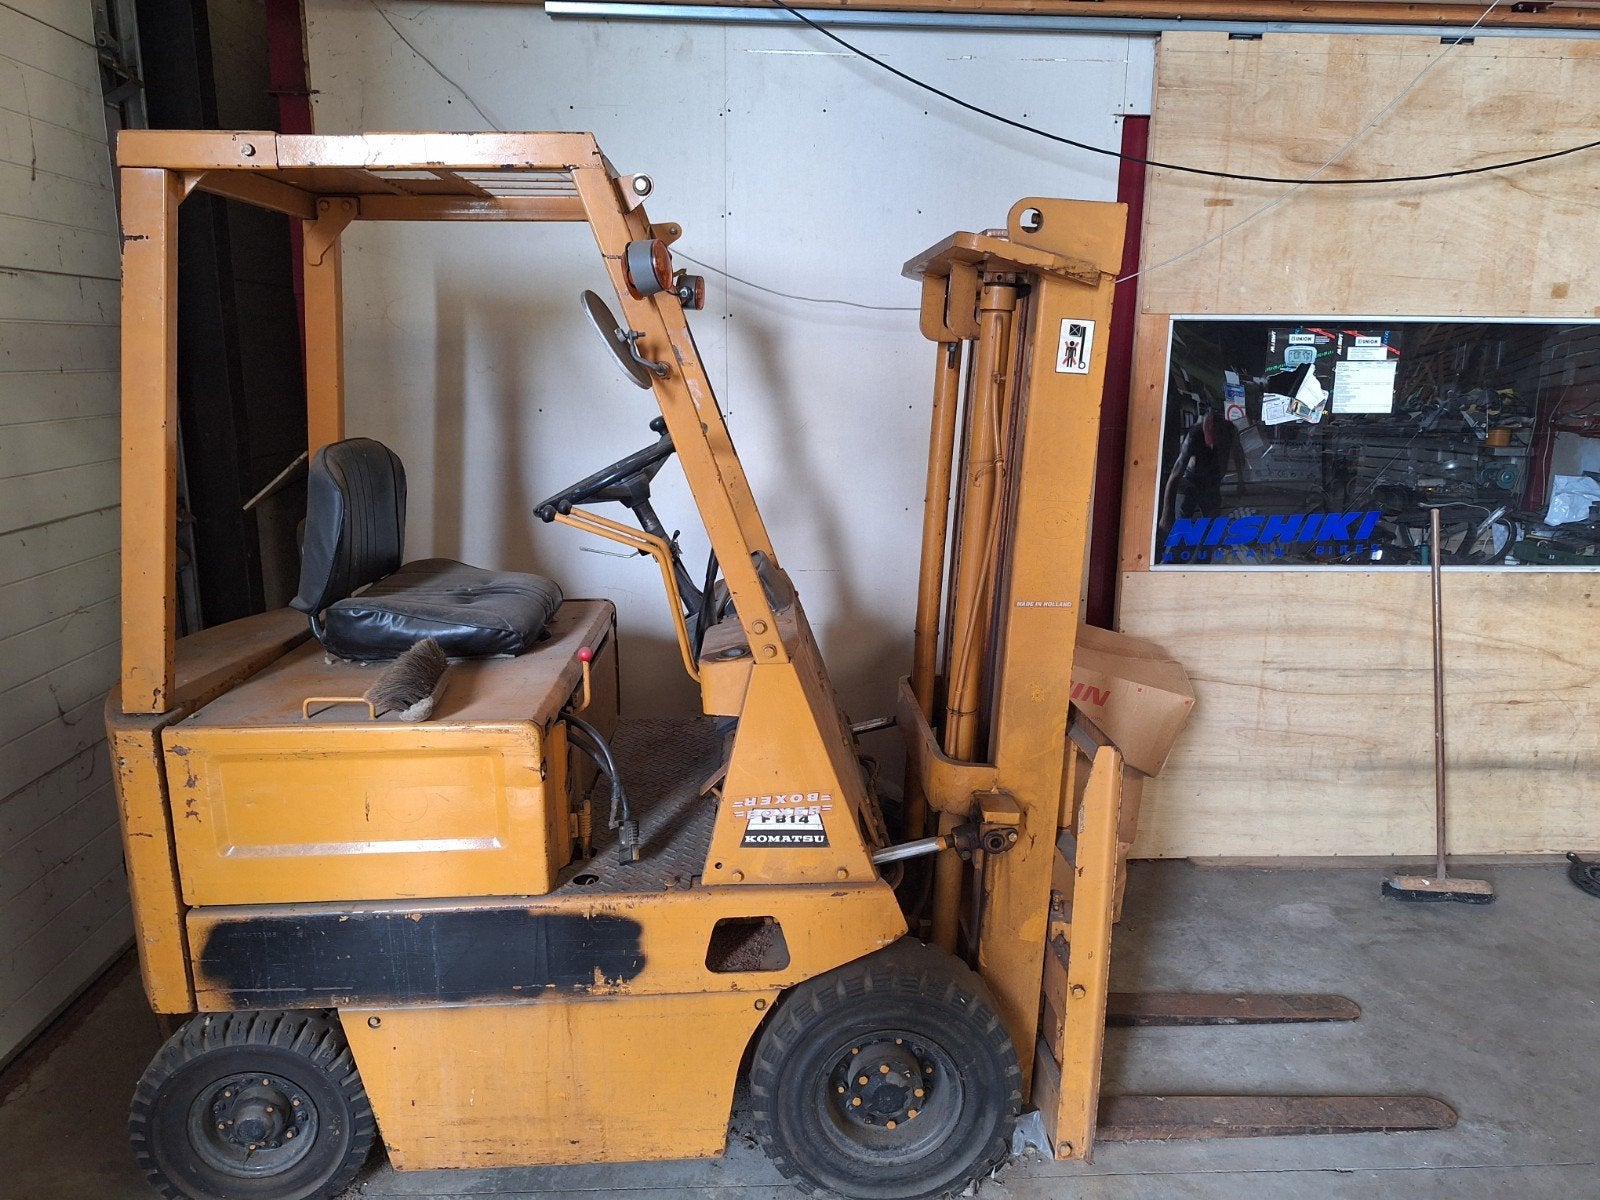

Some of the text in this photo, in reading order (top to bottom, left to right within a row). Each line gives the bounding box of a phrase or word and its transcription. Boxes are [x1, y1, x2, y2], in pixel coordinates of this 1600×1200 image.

[1163, 511, 1382, 547] NISHIKI
[1160, 543, 1382, 562] MOUNTAIN BIKES
[744, 792, 820, 807] BOXER
[744, 835, 825, 843] KOMATSU
